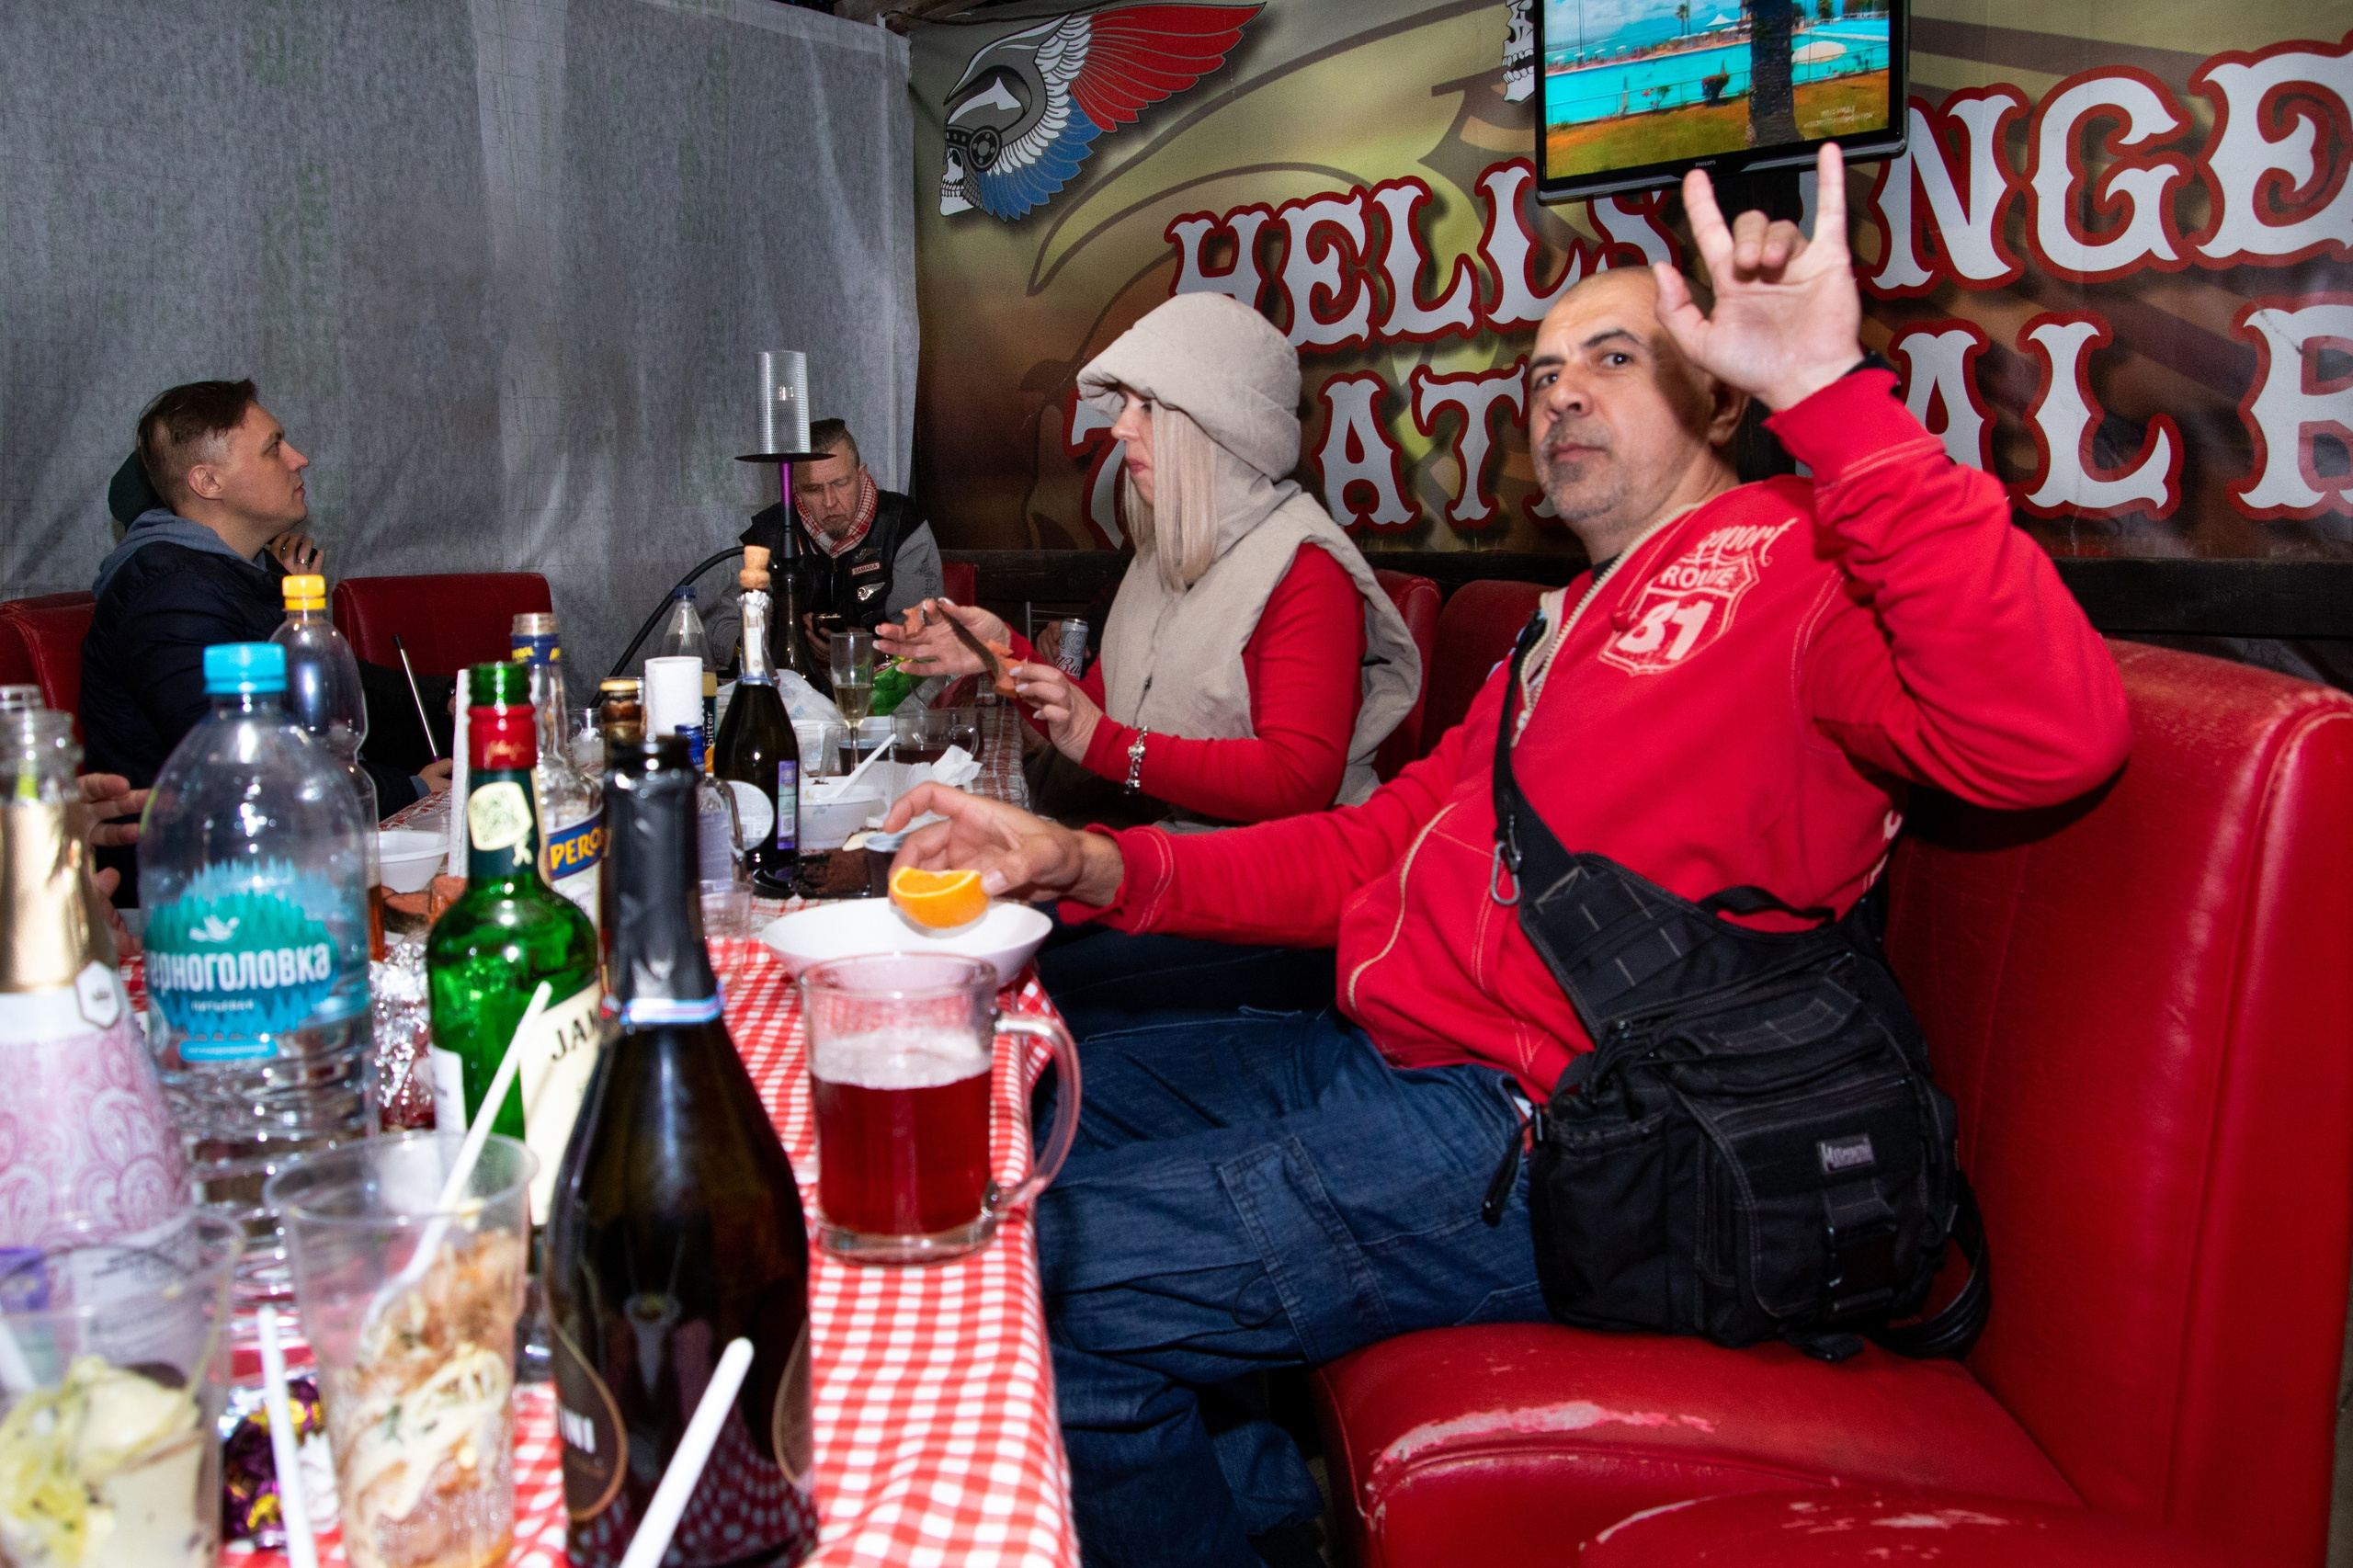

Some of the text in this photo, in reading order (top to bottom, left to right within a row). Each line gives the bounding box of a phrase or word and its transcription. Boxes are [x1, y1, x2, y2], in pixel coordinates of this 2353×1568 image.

[1695, 159, 1717, 168] PHILIPS
[853, 563, 878, 574] SAMARA
[1616, 599, 1715, 661] 81
[706, 710, 715, 747] bitter
[145, 942, 332, 997] ерноголовка
